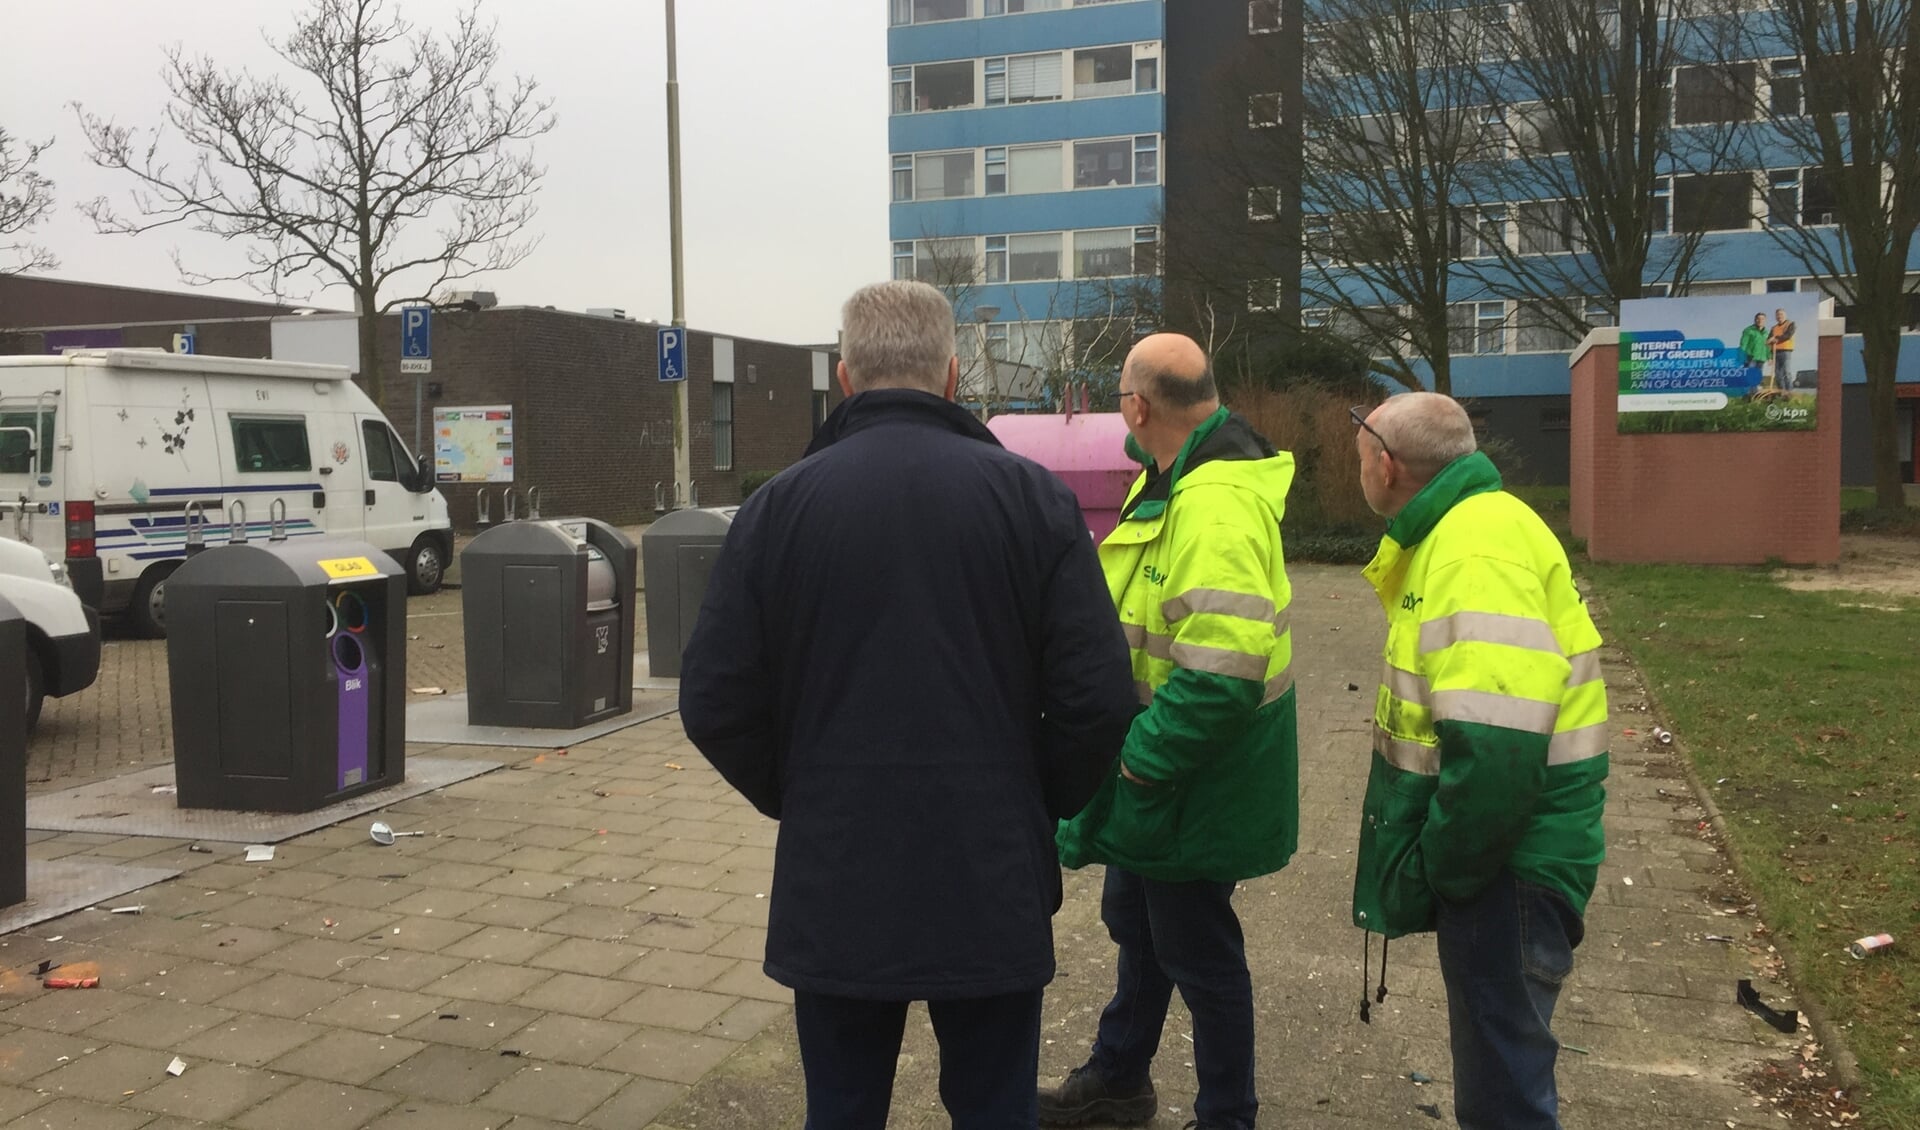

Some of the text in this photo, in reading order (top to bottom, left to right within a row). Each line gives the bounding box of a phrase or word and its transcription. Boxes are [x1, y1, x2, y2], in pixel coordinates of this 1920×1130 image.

[408, 311, 423, 337] P
[663, 332, 677, 359] P
[1631, 341, 1683, 351] INTERNET
[1631, 350, 1714, 360] BLIJFT GROEIEN
[1631, 358, 1737, 370] DAAROM SLUITEN WE
[1630, 367, 1750, 380] BERGEN OP ZOOM OOST
[1630, 379, 1728, 389] AAN OP GLASVEZEL
[1783, 407, 1808, 419] kpn
[345, 679, 362, 691] Blik
